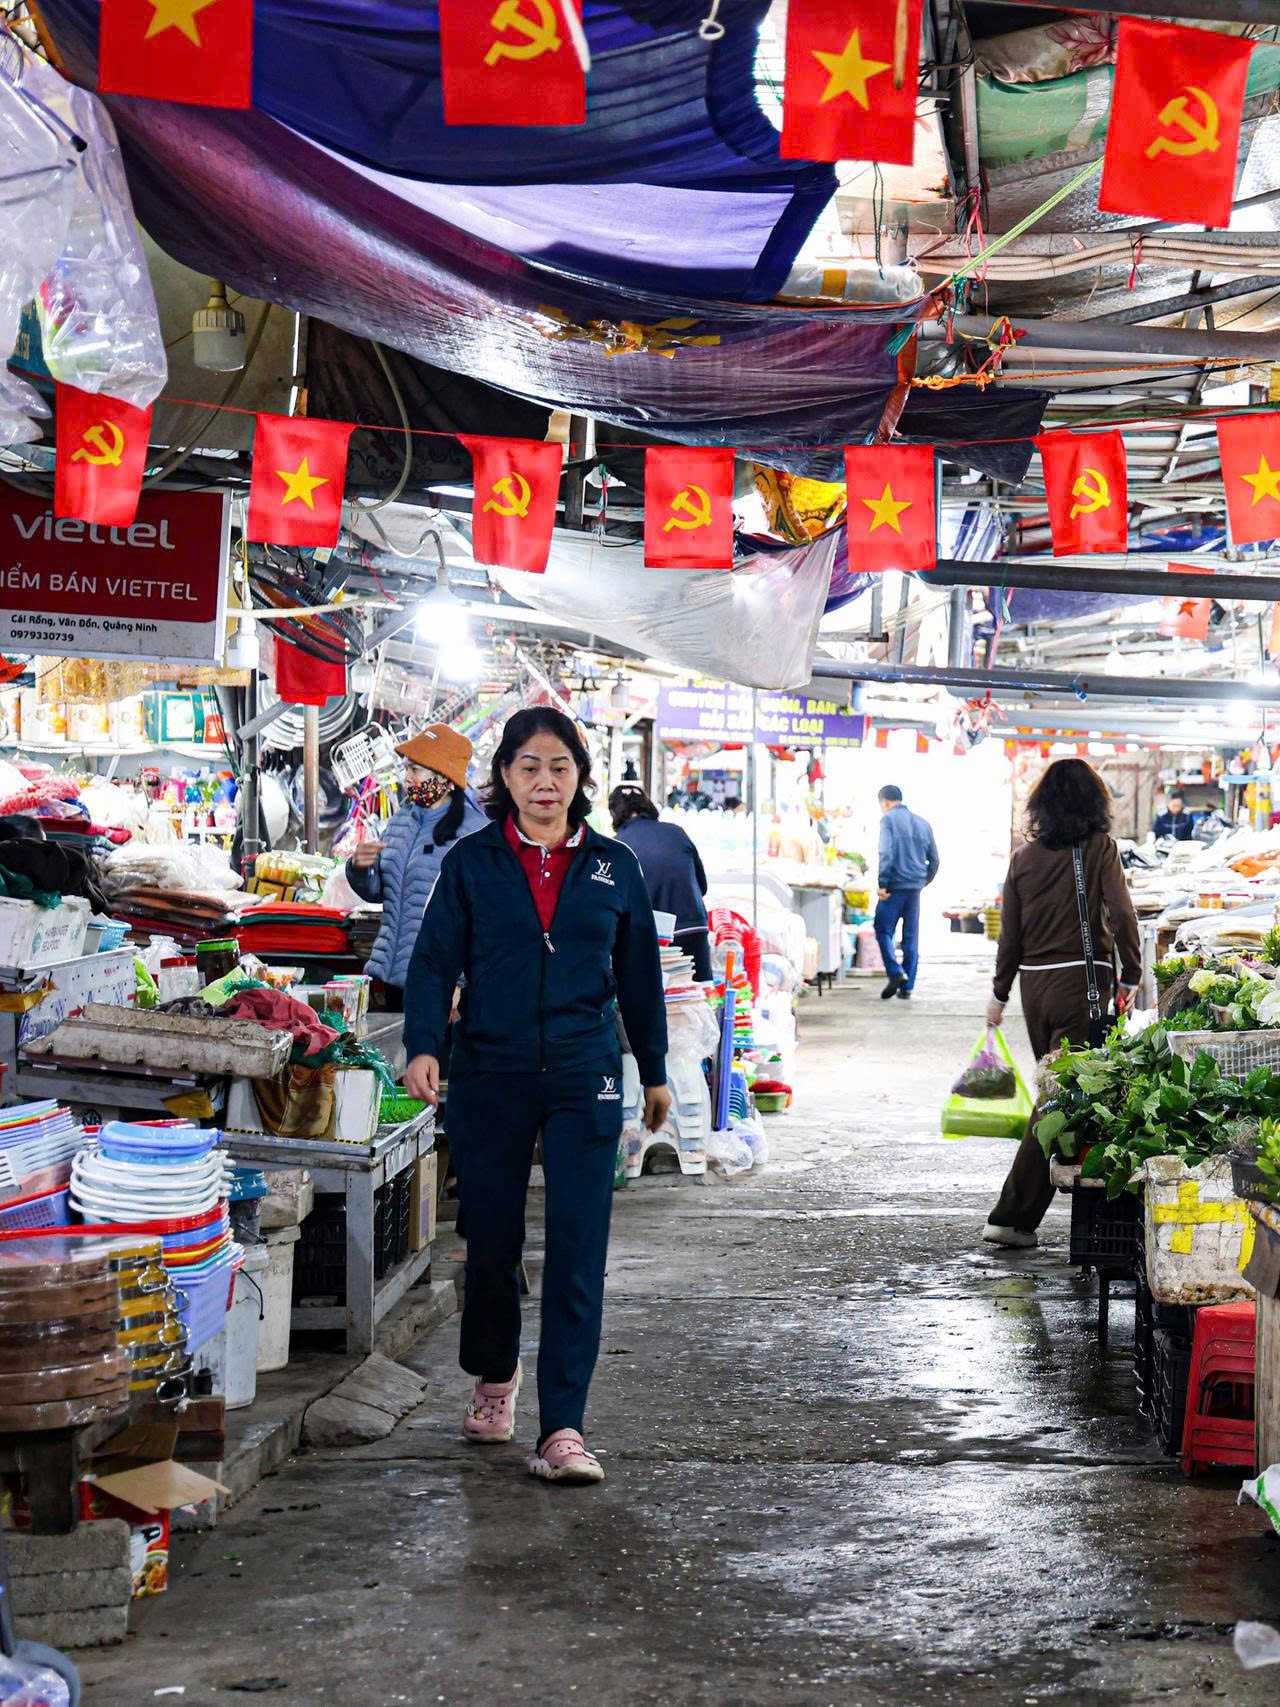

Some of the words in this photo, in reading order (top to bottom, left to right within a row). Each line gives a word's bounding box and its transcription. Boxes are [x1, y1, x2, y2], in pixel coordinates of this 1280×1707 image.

[0, 562, 40, 590] IỂM
[50, 571, 97, 594] BÁN
[106, 577, 198, 601] VIETTEL
[135, 621, 158, 633] Ninh
[10, 629, 74, 642] 0979330739
